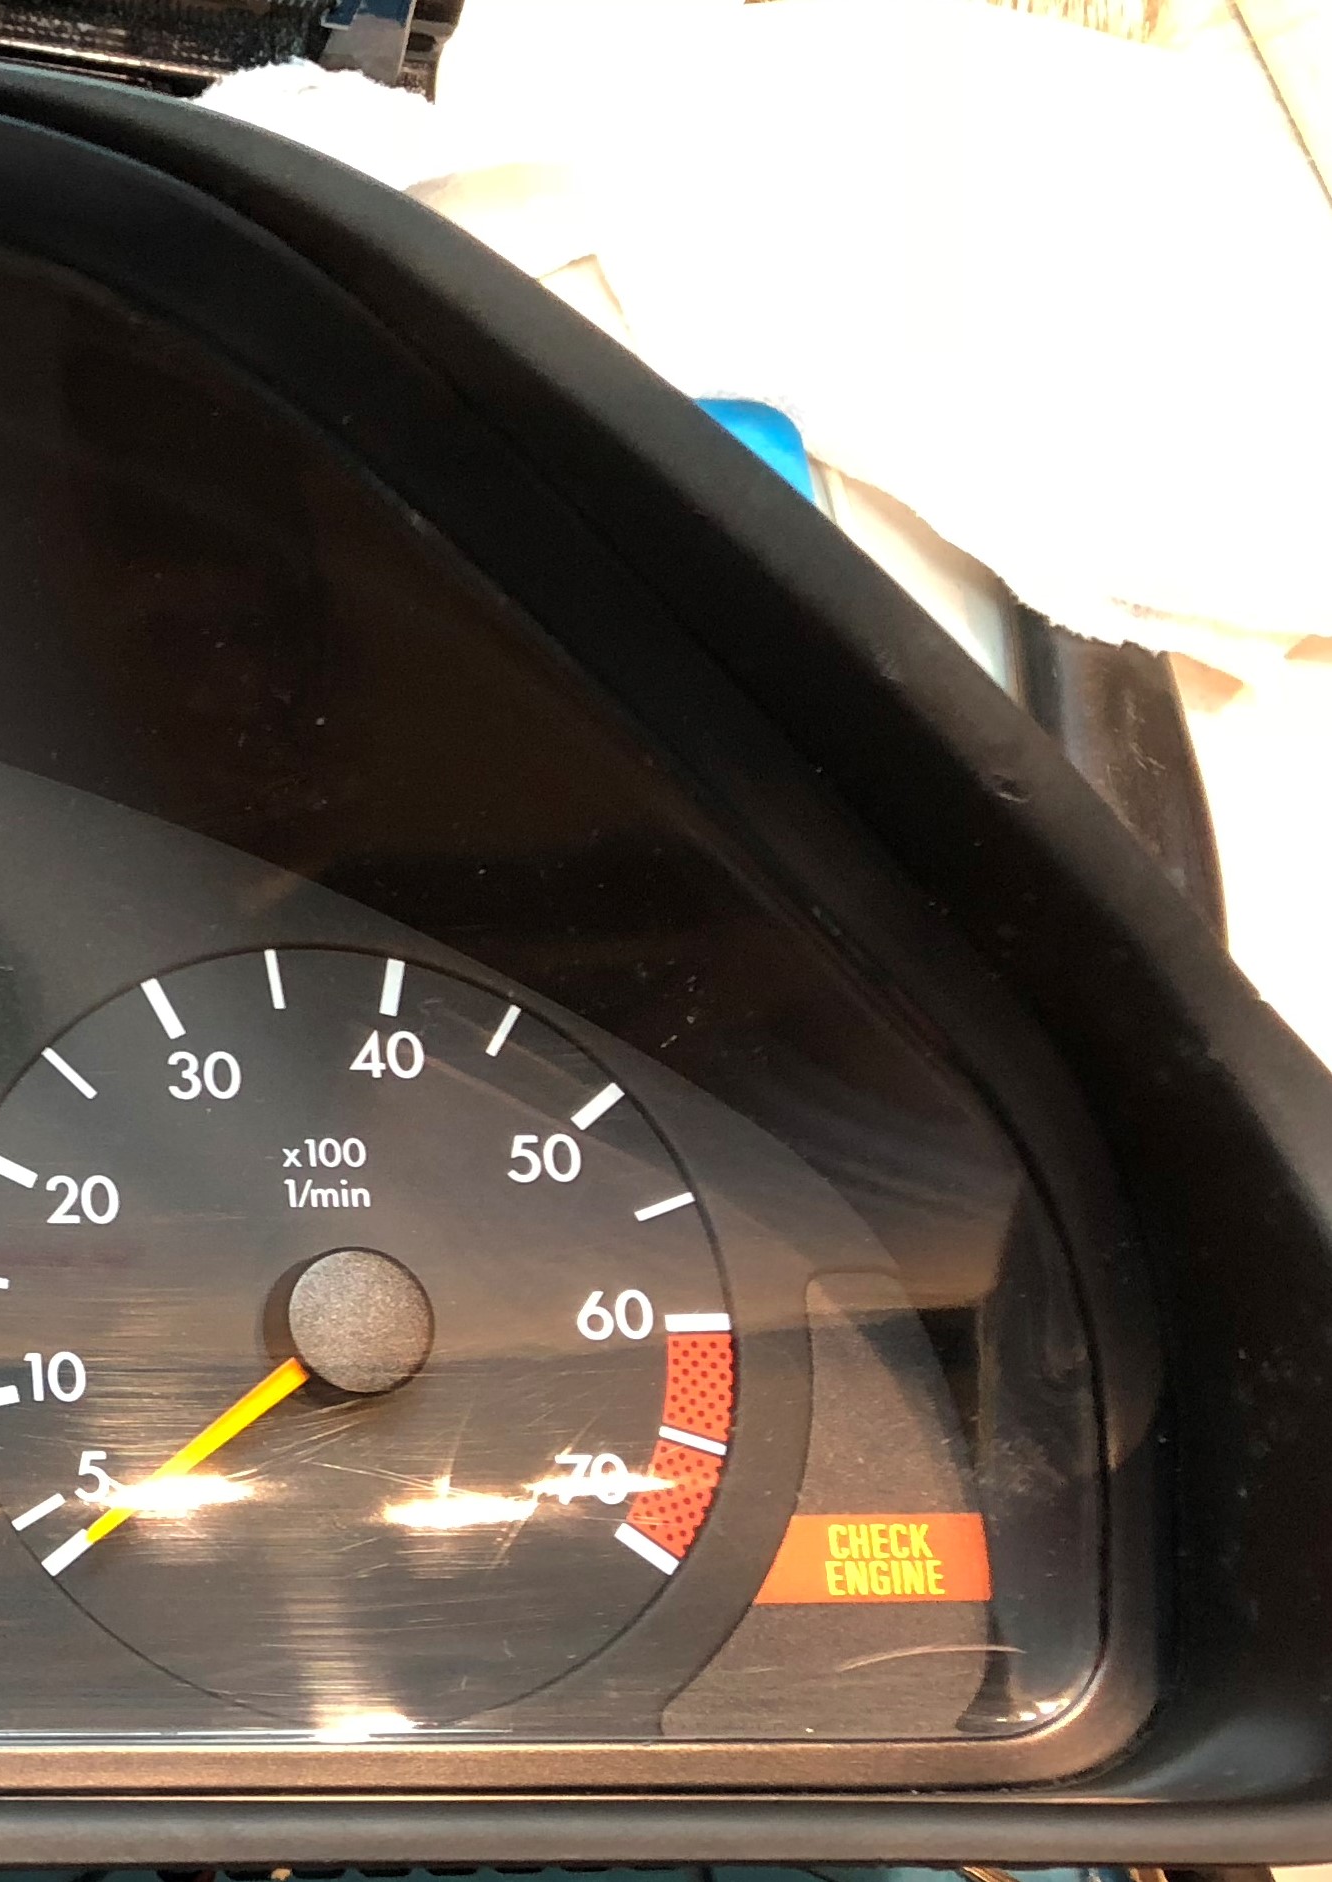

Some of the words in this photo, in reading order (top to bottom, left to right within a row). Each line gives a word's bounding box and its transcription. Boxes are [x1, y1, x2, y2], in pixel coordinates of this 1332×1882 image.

[168, 1052, 240, 1099] 30
[350, 1031, 424, 1078] 40
[283, 1138, 366, 1167] x100
[508, 1134, 580, 1182] 50
[46, 1175, 119, 1224] 20
[284, 1179, 370, 1207] 1/min
[577, 1290, 653, 1340] 60
[24, 1352, 86, 1402] 10
[75, 1451, 113, 1504] 5
[553, 1453, 630, 1505] 70
[827, 1523, 933, 1559] CHECK
[825, 1560, 945, 1596] ENGINE
